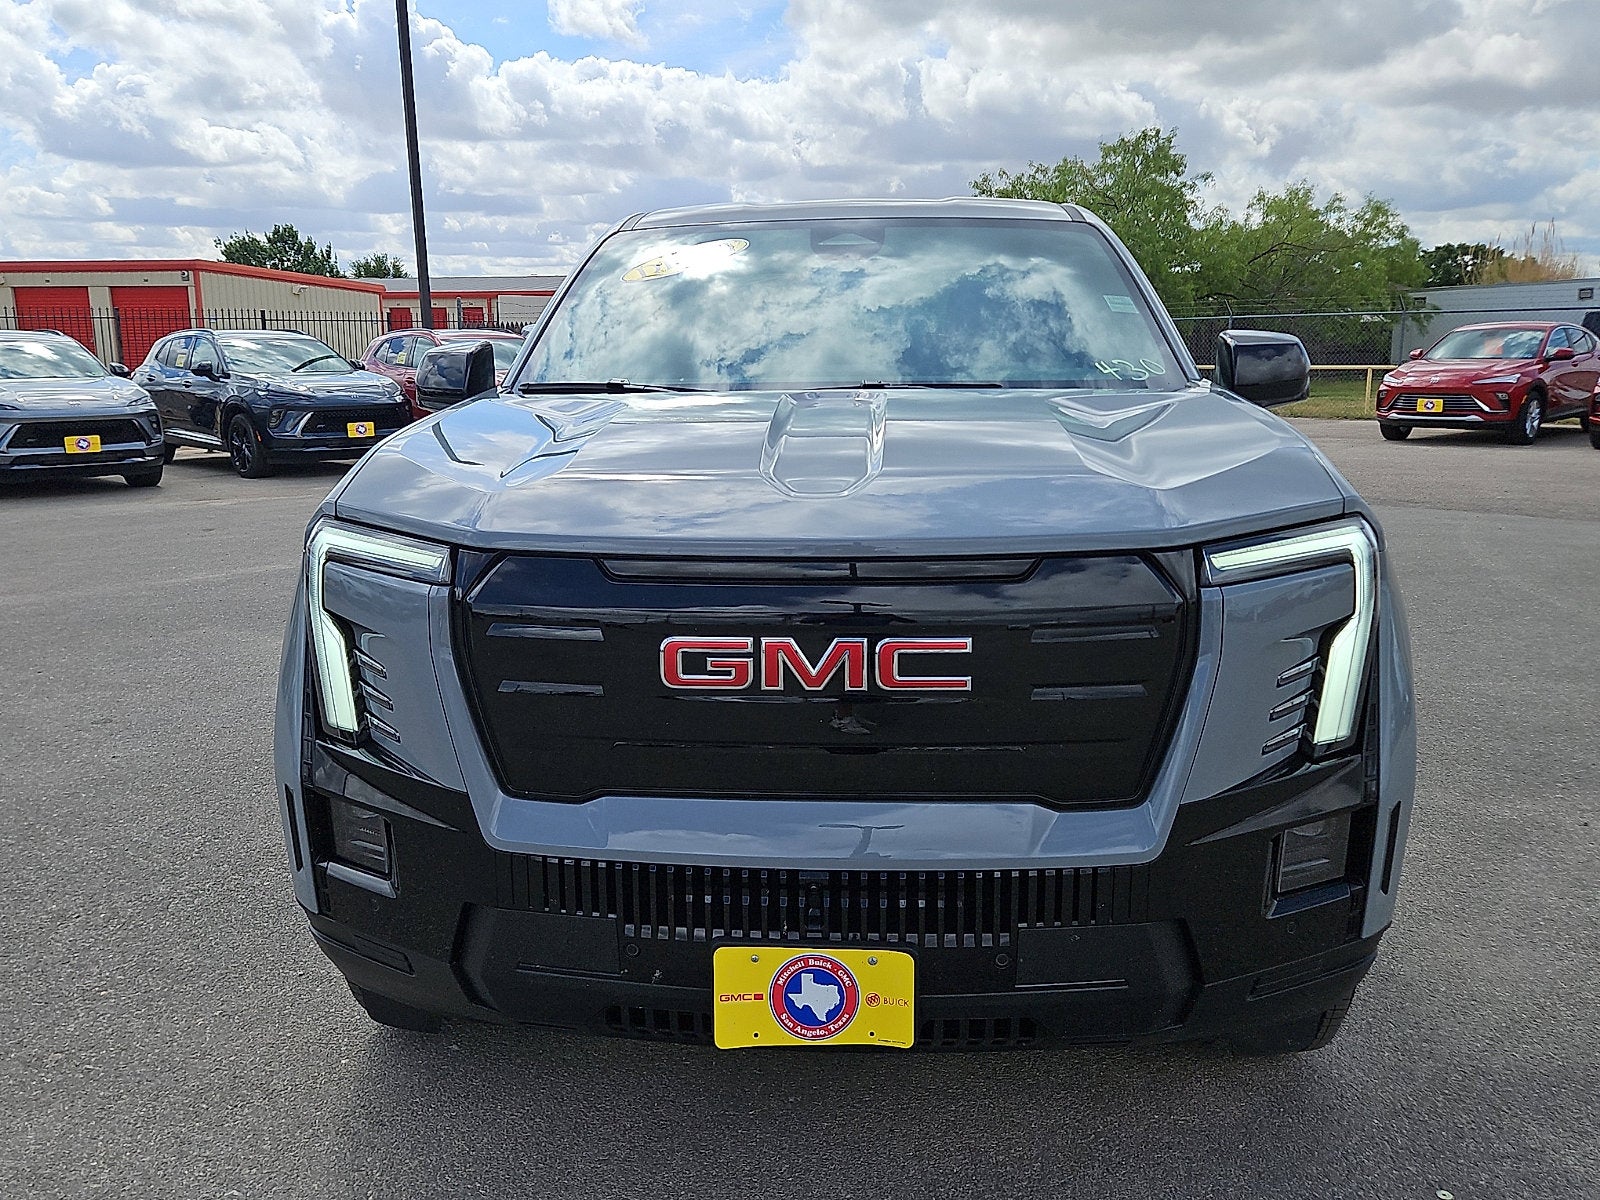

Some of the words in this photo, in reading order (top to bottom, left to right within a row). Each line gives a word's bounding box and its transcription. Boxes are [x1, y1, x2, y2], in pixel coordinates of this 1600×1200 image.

[1094, 359, 1166, 381] 430
[660, 636, 972, 691] GMC
[777, 960, 805, 986] Mitchell
[808, 958, 833, 970] Buick
[837, 970, 853, 988] GMC
[719, 993, 753, 1002] GMC
[883, 997, 909, 1008] BUICK
[780, 1012, 794, 1028] San
[794, 1026, 829, 1038] Angelo,
[828, 1013, 850, 1032] Texas
